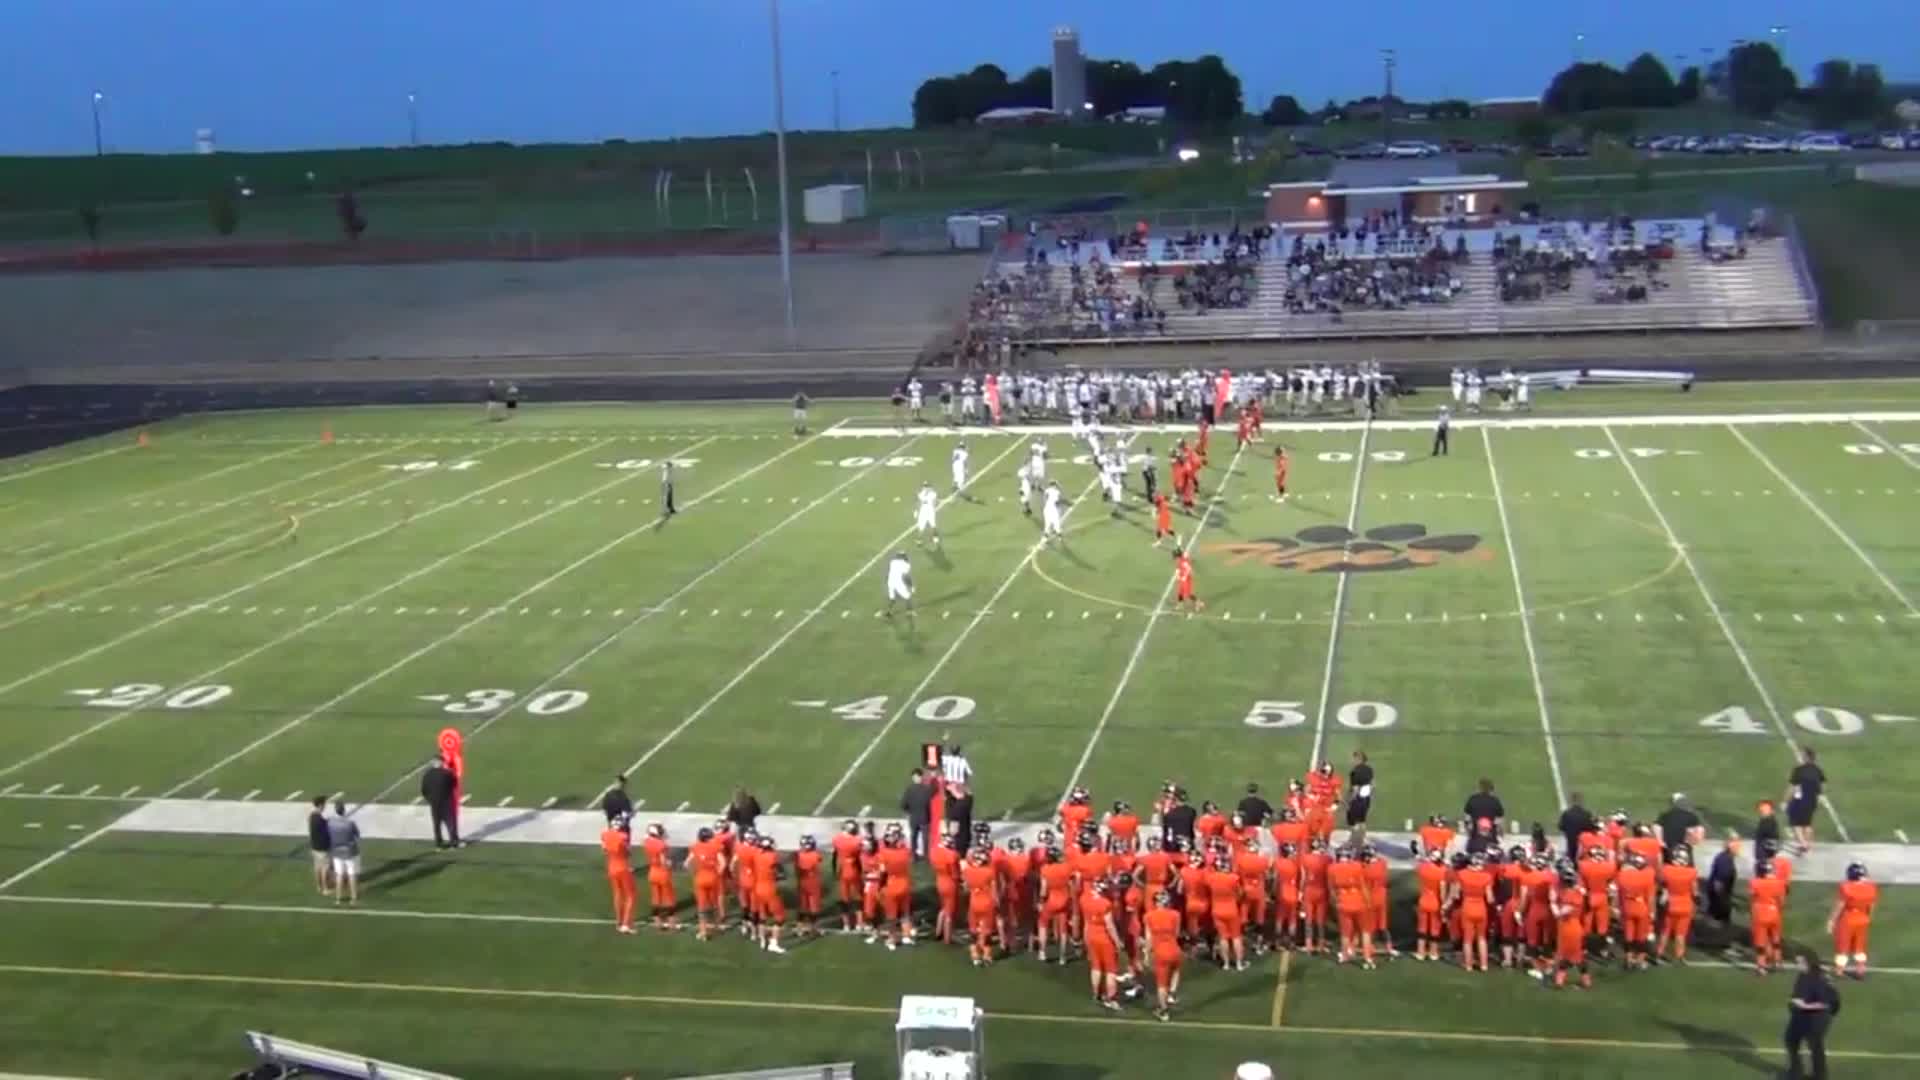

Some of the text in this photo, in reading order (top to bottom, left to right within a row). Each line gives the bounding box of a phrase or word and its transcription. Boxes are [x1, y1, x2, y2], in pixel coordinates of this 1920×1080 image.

[87, 684, 232, 708] 20
[442, 689, 590, 715] 30
[831, 695, 977, 721] 40
[1243, 700, 1398, 729] 50
[1698, 705, 1865, 736] 40
